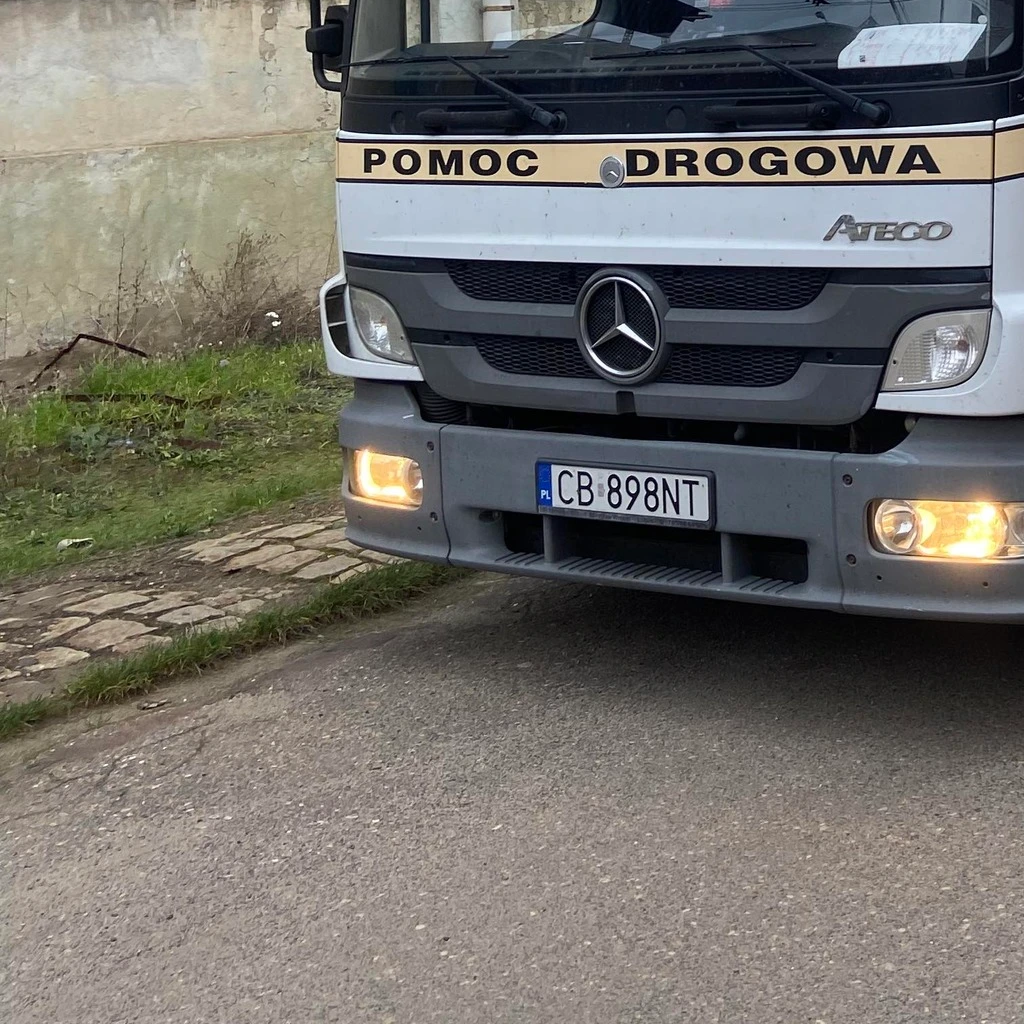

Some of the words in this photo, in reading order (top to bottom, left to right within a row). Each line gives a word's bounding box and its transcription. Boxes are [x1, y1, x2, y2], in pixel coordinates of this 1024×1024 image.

[363, 148, 539, 176] POMOC
[625, 144, 942, 176] DROGOWA
[540, 488, 552, 500] PL
[557, 469, 595, 507] CB
[606, 473, 700, 517] 898NT
